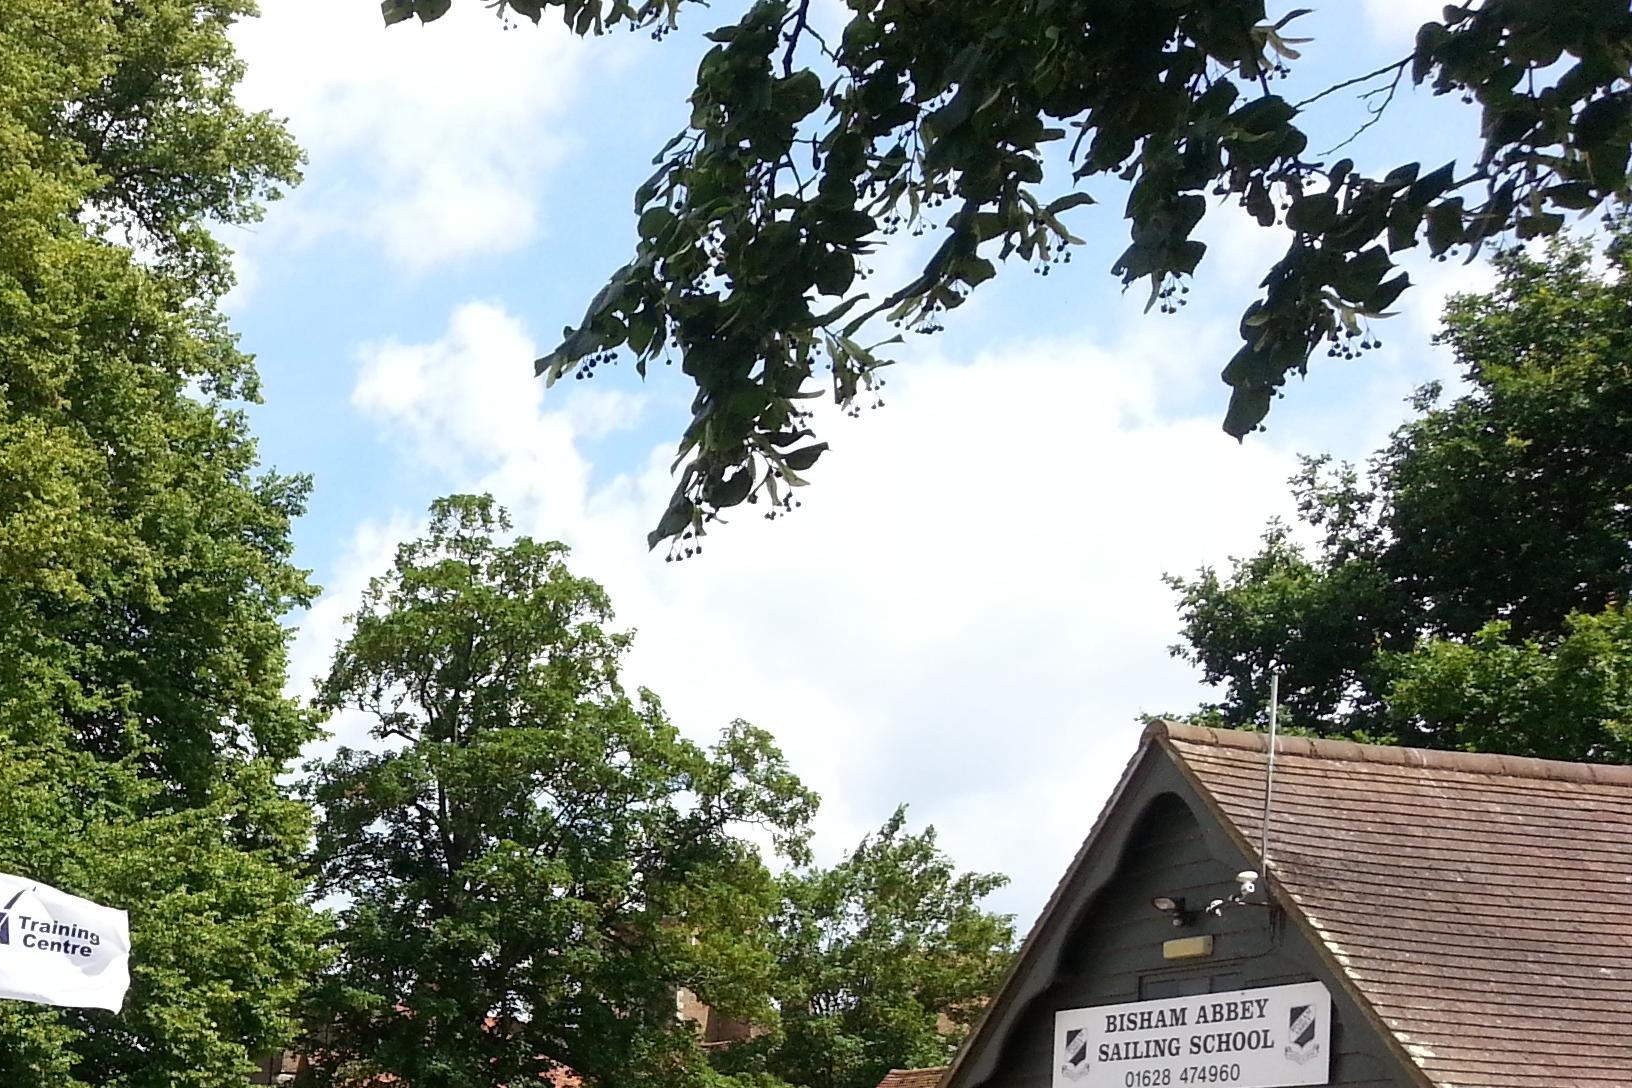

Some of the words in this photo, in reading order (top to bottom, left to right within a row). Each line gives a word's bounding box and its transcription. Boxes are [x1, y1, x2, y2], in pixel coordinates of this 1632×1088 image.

[18, 915, 101, 946] Training
[22, 933, 92, 957] Centre
[1104, 1007, 1188, 1033] BISHAM
[1194, 998, 1270, 1025] ABBEY
[1098, 1037, 1182, 1062] SAILING
[1189, 1029, 1275, 1055] SCHOOL
[1125, 1068, 1171, 1088] 01628
[1179, 1063, 1241, 1084] 474960
